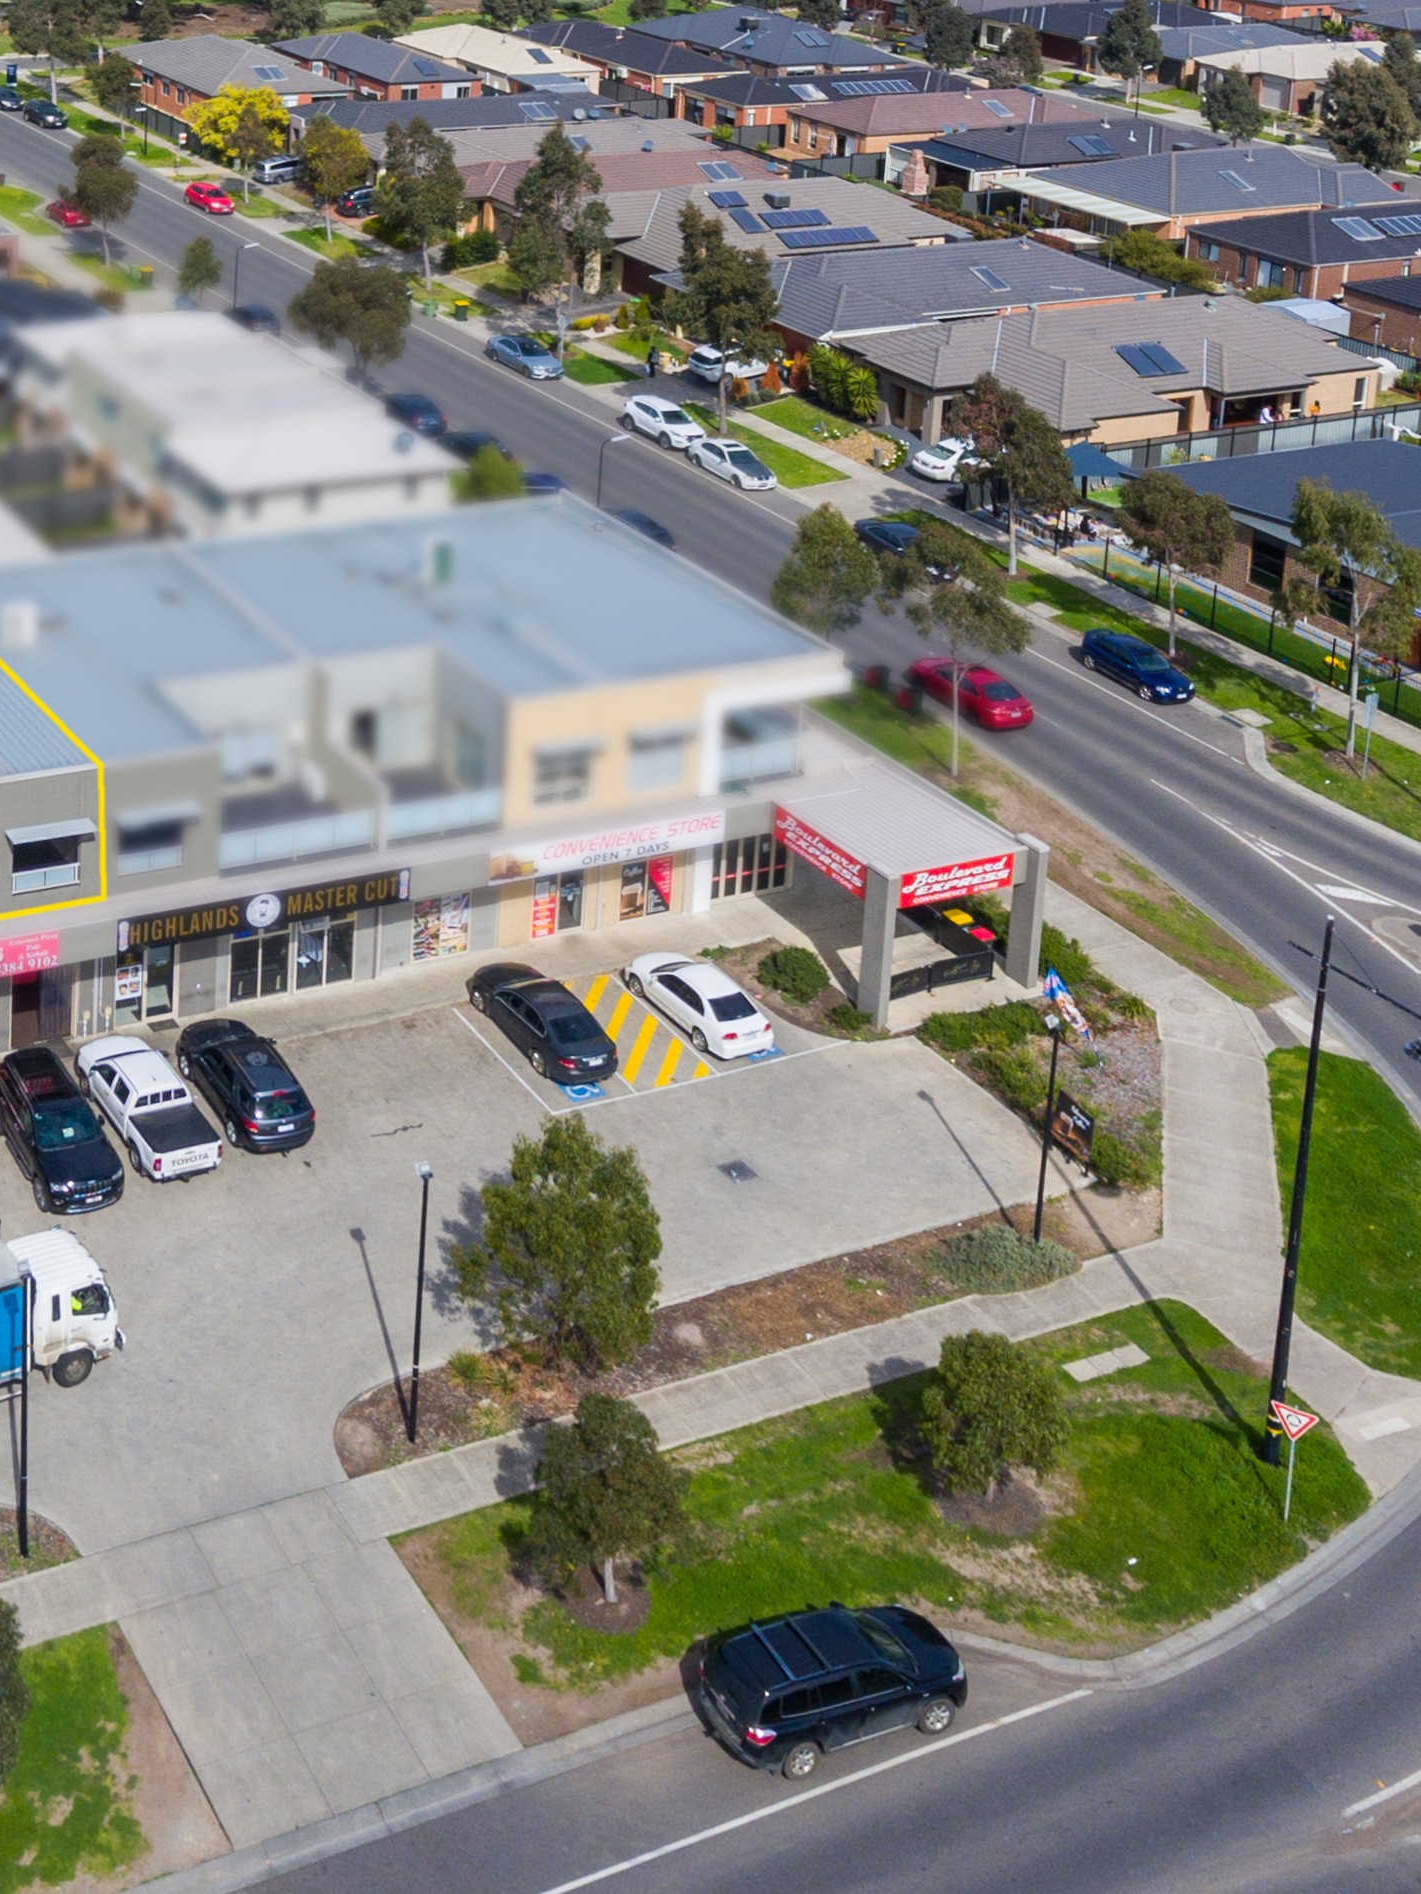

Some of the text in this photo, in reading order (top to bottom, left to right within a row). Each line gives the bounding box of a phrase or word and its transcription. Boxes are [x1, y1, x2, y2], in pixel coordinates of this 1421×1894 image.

[543, 814, 722, 860] CONVENIENCE STORE
[582, 841, 670, 866] OPEN 7 DAYS
[776, 816, 861, 875] Boulevard
[786, 831, 863, 887] EXPRESS
[901, 856, 1008, 894] Boulevard
[287, 884, 357, 916] MASTER
[365, 877, 399, 901] CUT
[914, 869, 1010, 896] EXPRESS
[130, 905, 239, 945] HIGHLANDS
[28, 955, 59, 969] 9102
[171, 1152, 209, 1167] TOYOTA
